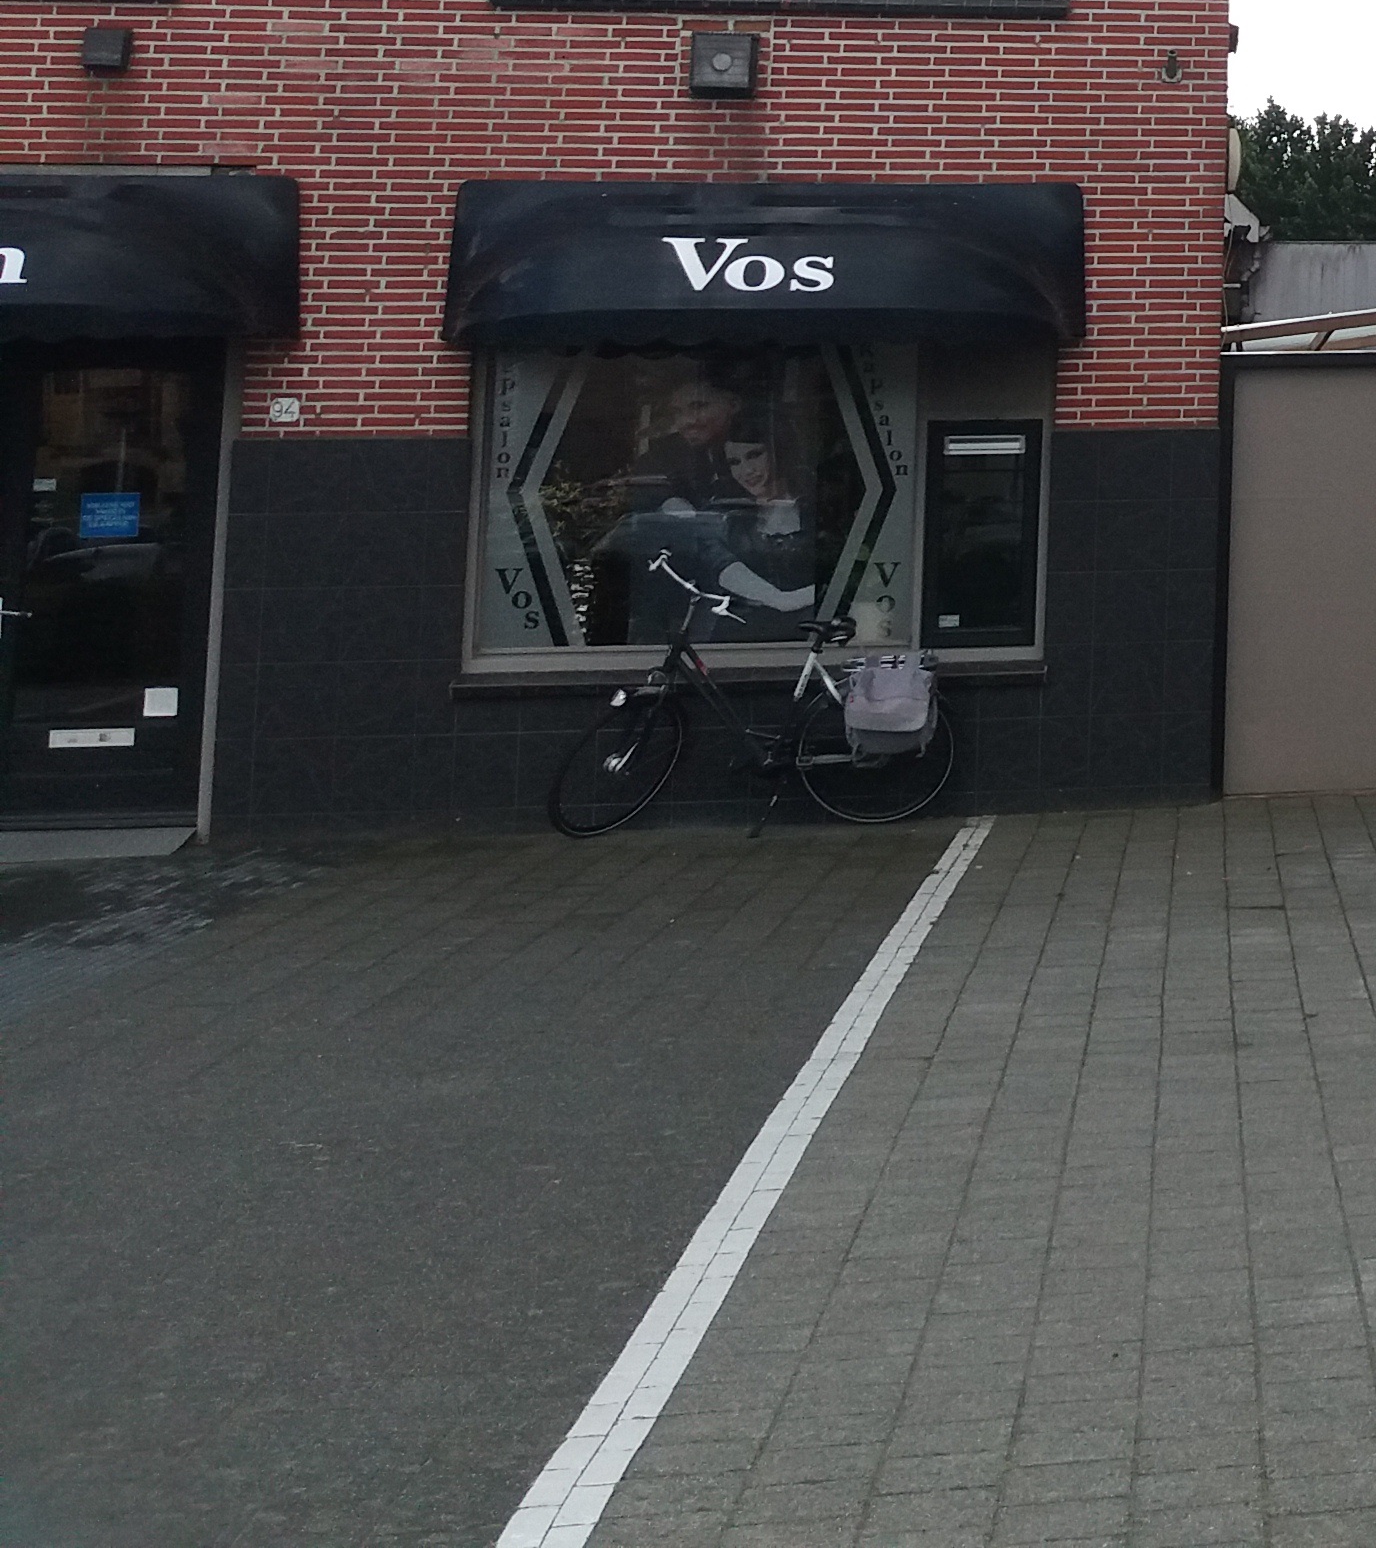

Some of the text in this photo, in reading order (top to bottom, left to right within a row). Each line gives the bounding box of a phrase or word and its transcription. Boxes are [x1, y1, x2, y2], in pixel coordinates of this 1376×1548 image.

[661, 237, 834, 292] Vos
[272, 400, 297, 419] 94
[495, 567, 541, 630] Vos
